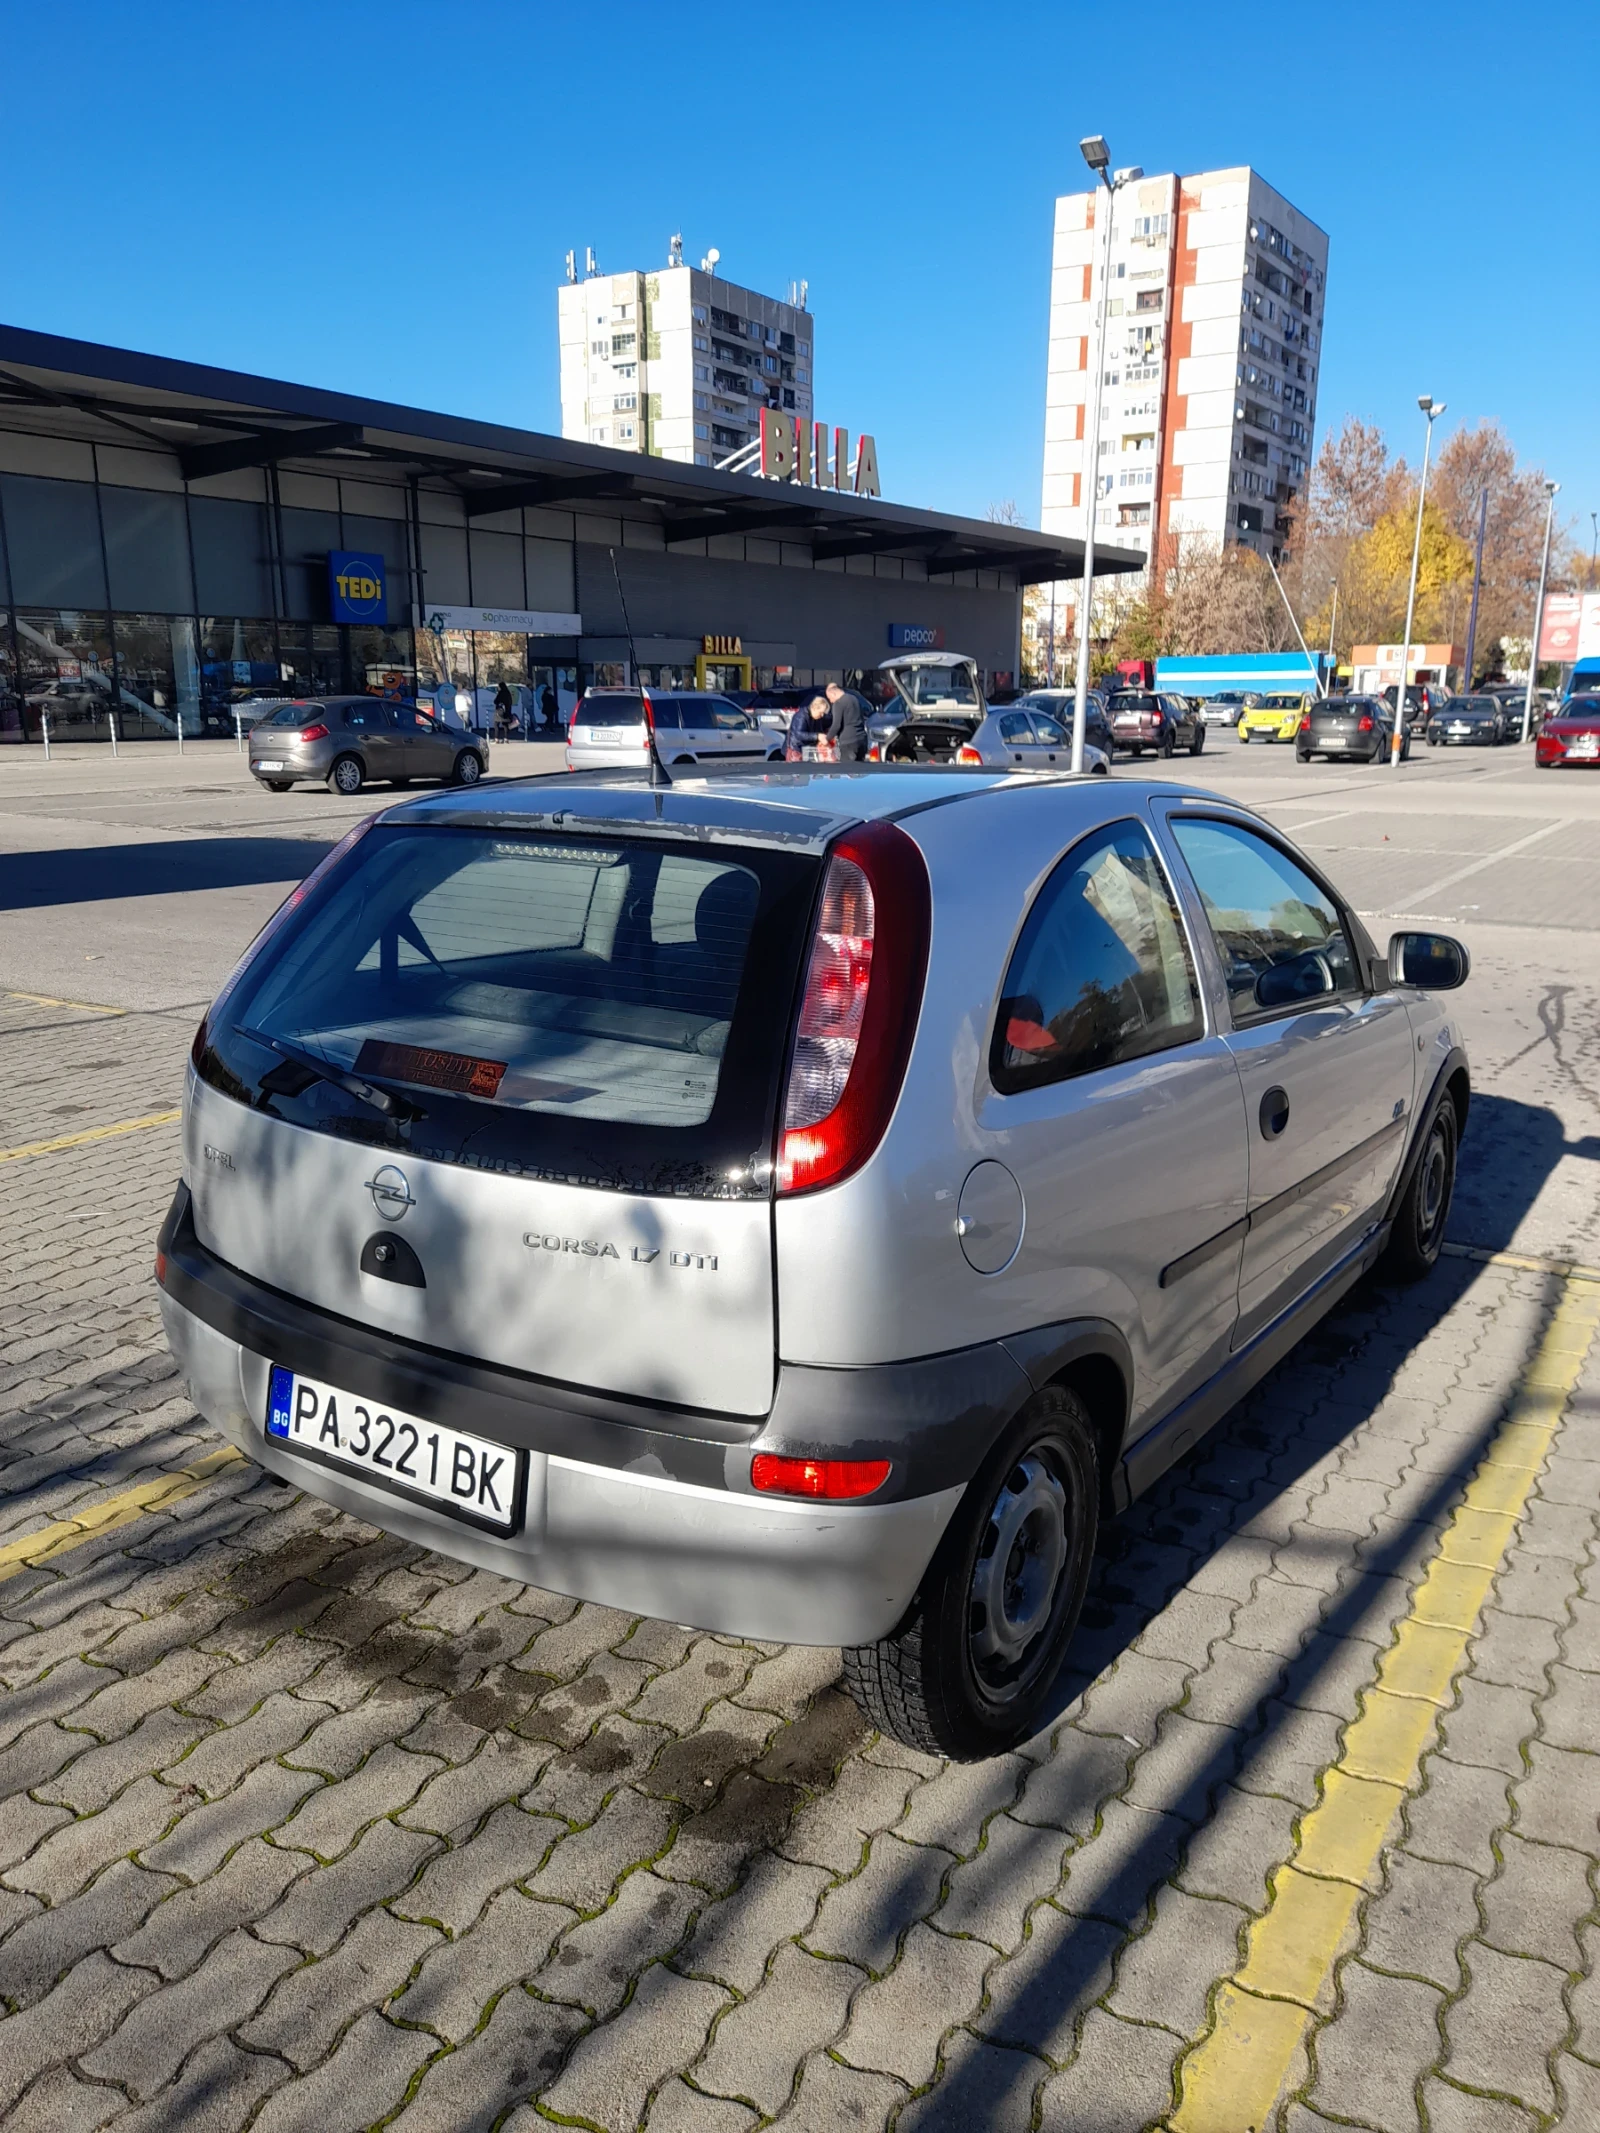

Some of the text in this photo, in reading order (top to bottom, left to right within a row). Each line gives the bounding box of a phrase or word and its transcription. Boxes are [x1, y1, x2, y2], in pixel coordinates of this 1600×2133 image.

[760, 406, 881, 498] BILLA
[336, 575, 382, 600] TEDi
[703, 634, 742, 655] BILLA
[904, 629, 936, 646] pepco
[203, 1143, 236, 1172] OPEL
[522, 1231, 621, 1260] CORSA
[669, 1250, 719, 1271] DTI
[273, 1409, 289, 1427] BG
